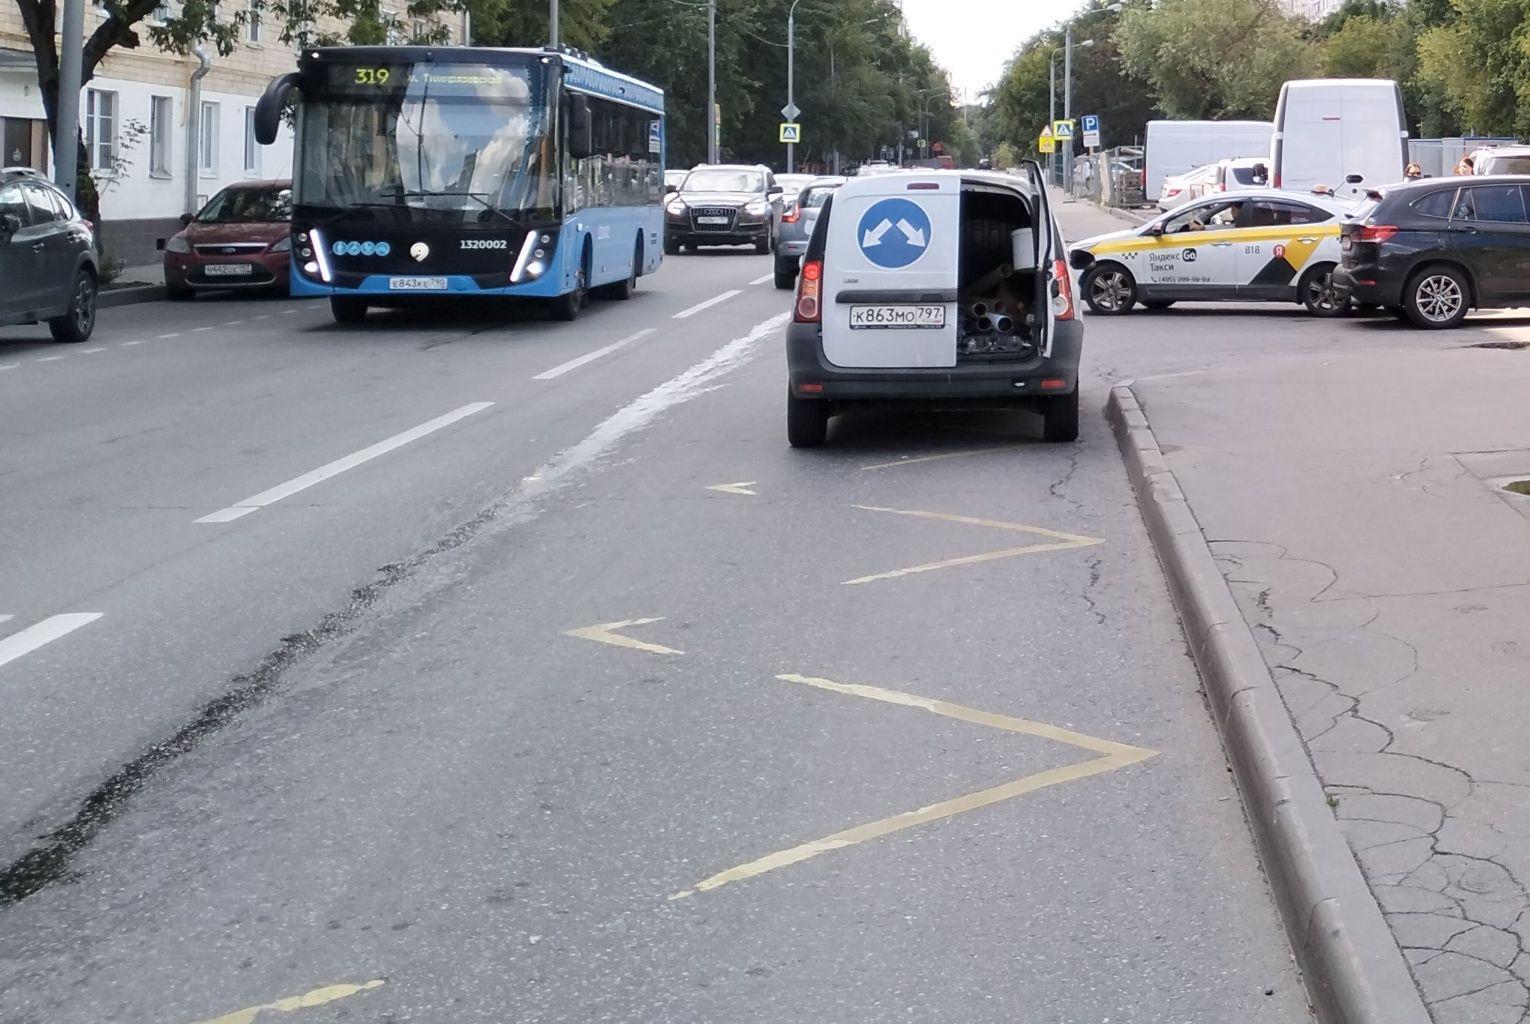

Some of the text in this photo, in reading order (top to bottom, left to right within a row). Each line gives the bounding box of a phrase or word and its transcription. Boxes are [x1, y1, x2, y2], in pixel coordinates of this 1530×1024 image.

[354, 68, 389, 84] 319
[460, 240, 507, 249] 1320002
[1245, 246, 1260, 254] 818
[1148, 249, 1196, 262] Яндекс Go
[1150, 263, 1174, 272] Такси
[856, 307, 941, 323] К863МО 797
